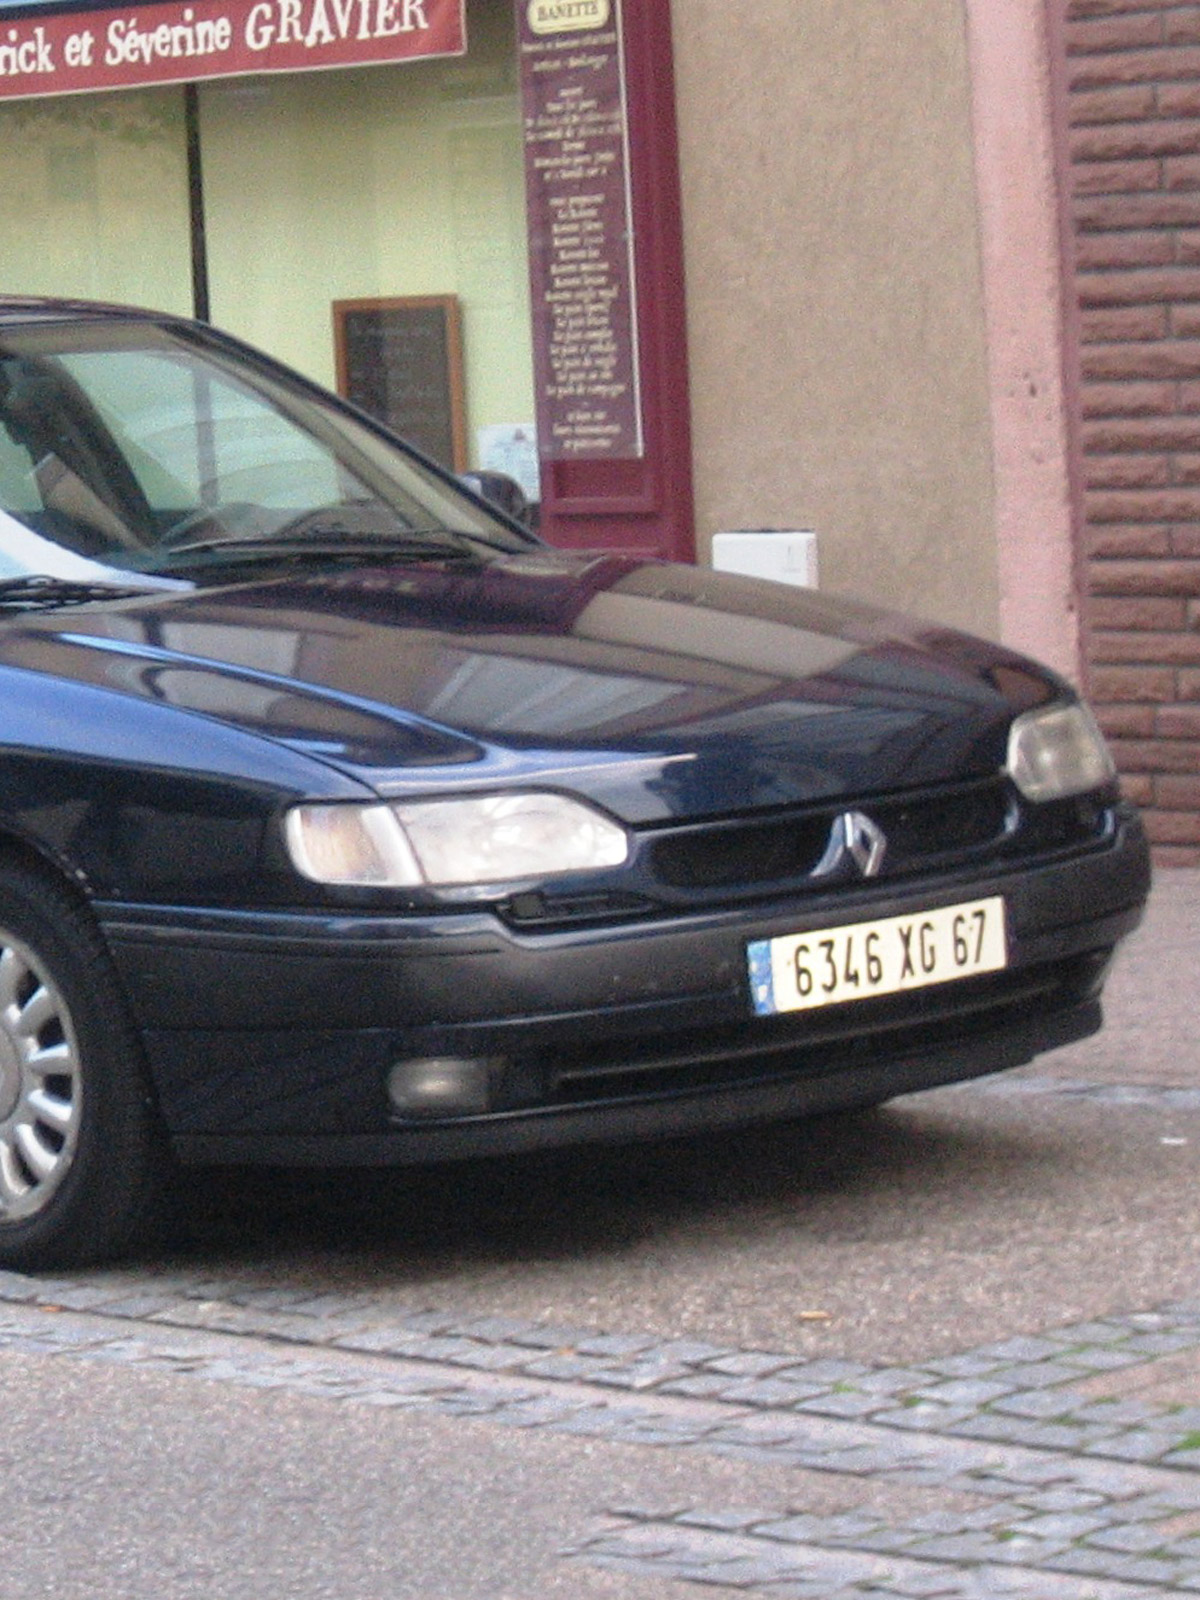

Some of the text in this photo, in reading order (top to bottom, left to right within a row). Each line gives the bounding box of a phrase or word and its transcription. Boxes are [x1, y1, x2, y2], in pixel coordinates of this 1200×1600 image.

[64, 30, 94, 66] et
[105, 8, 231, 65] Séverine
[245, 0, 429, 50] GRAVIER
[794, 909, 985, 996] 6346 XG 67
